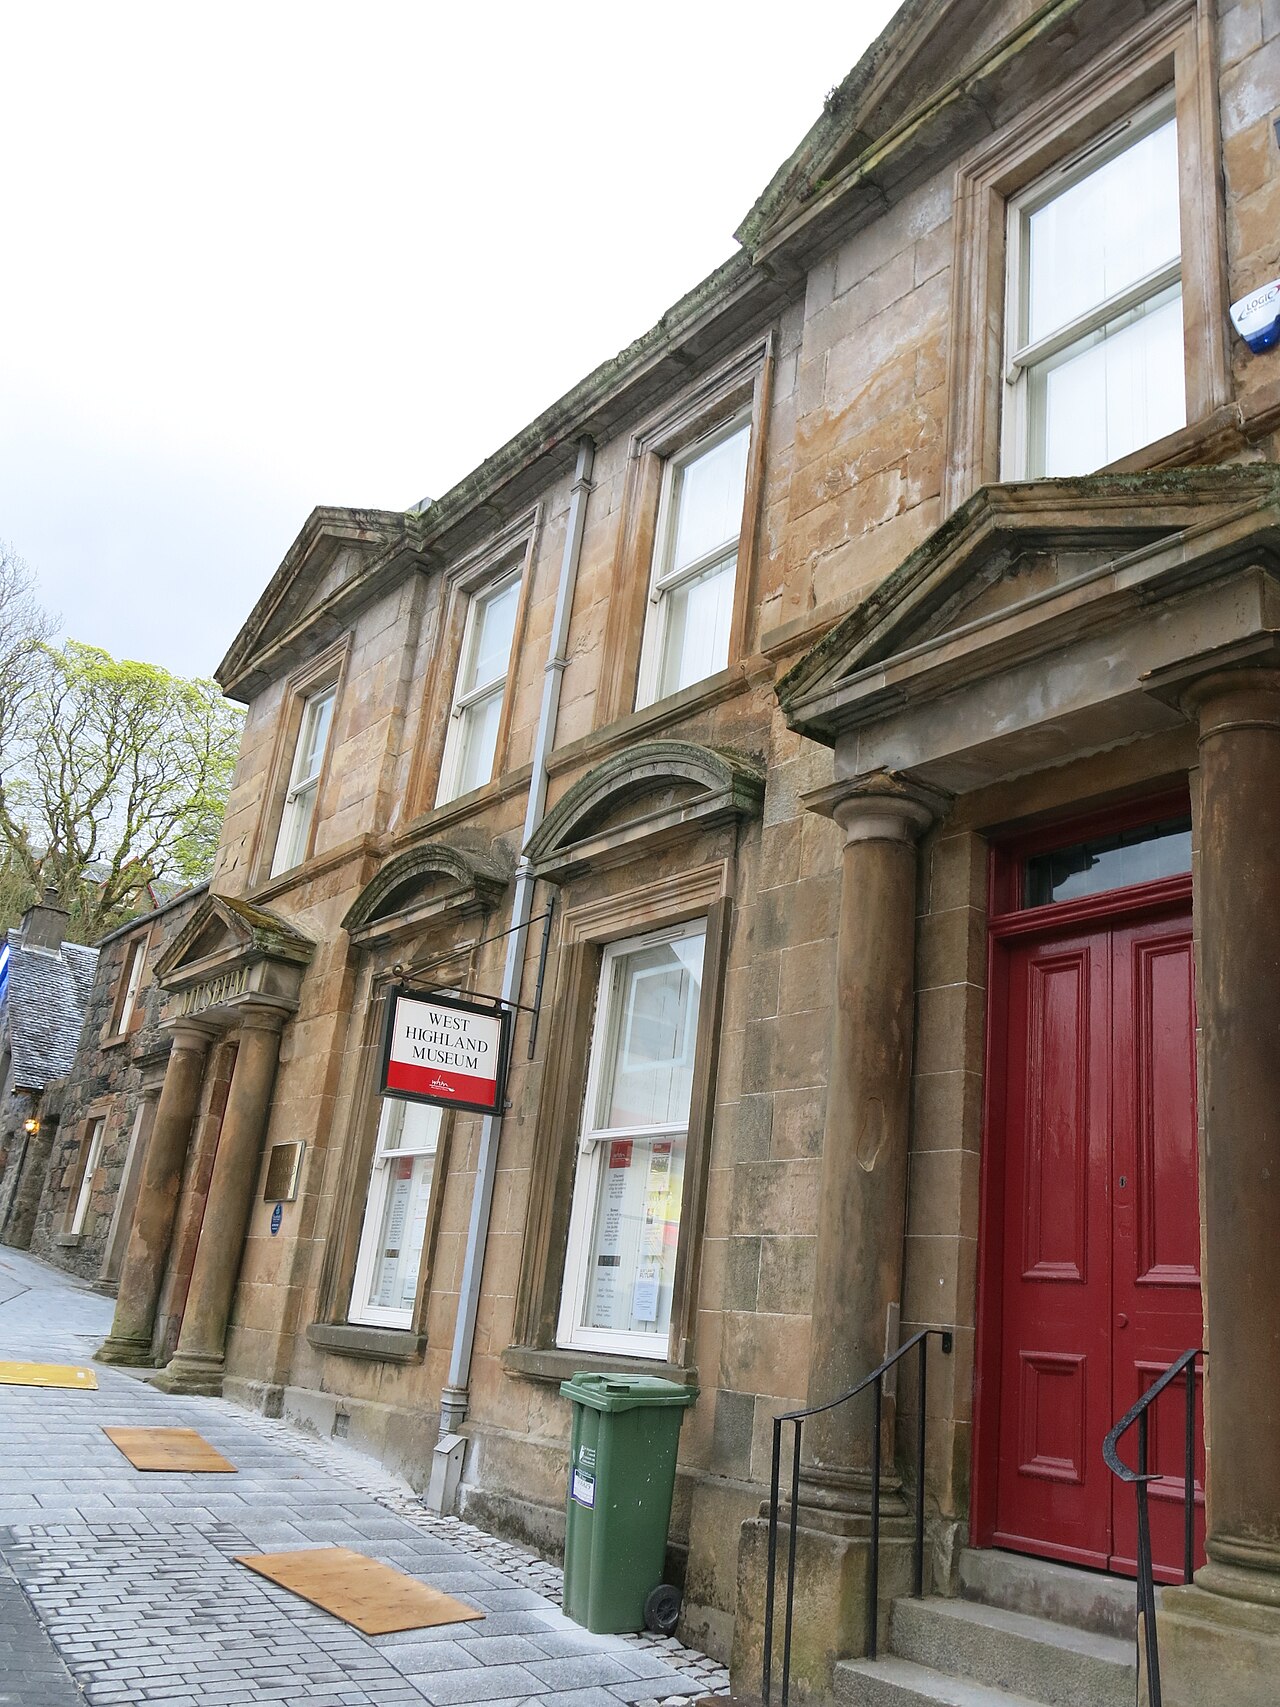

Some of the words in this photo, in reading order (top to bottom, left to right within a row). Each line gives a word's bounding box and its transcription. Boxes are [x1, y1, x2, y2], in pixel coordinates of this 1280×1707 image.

[1246, 291, 1274, 311] LOGIC
[181, 966, 249, 1016] MUSEUM
[429, 1012, 470, 1032] WEST
[405, 1026, 488, 1053] HIGHLAND
[412, 1046, 478, 1069] MUSEUM
